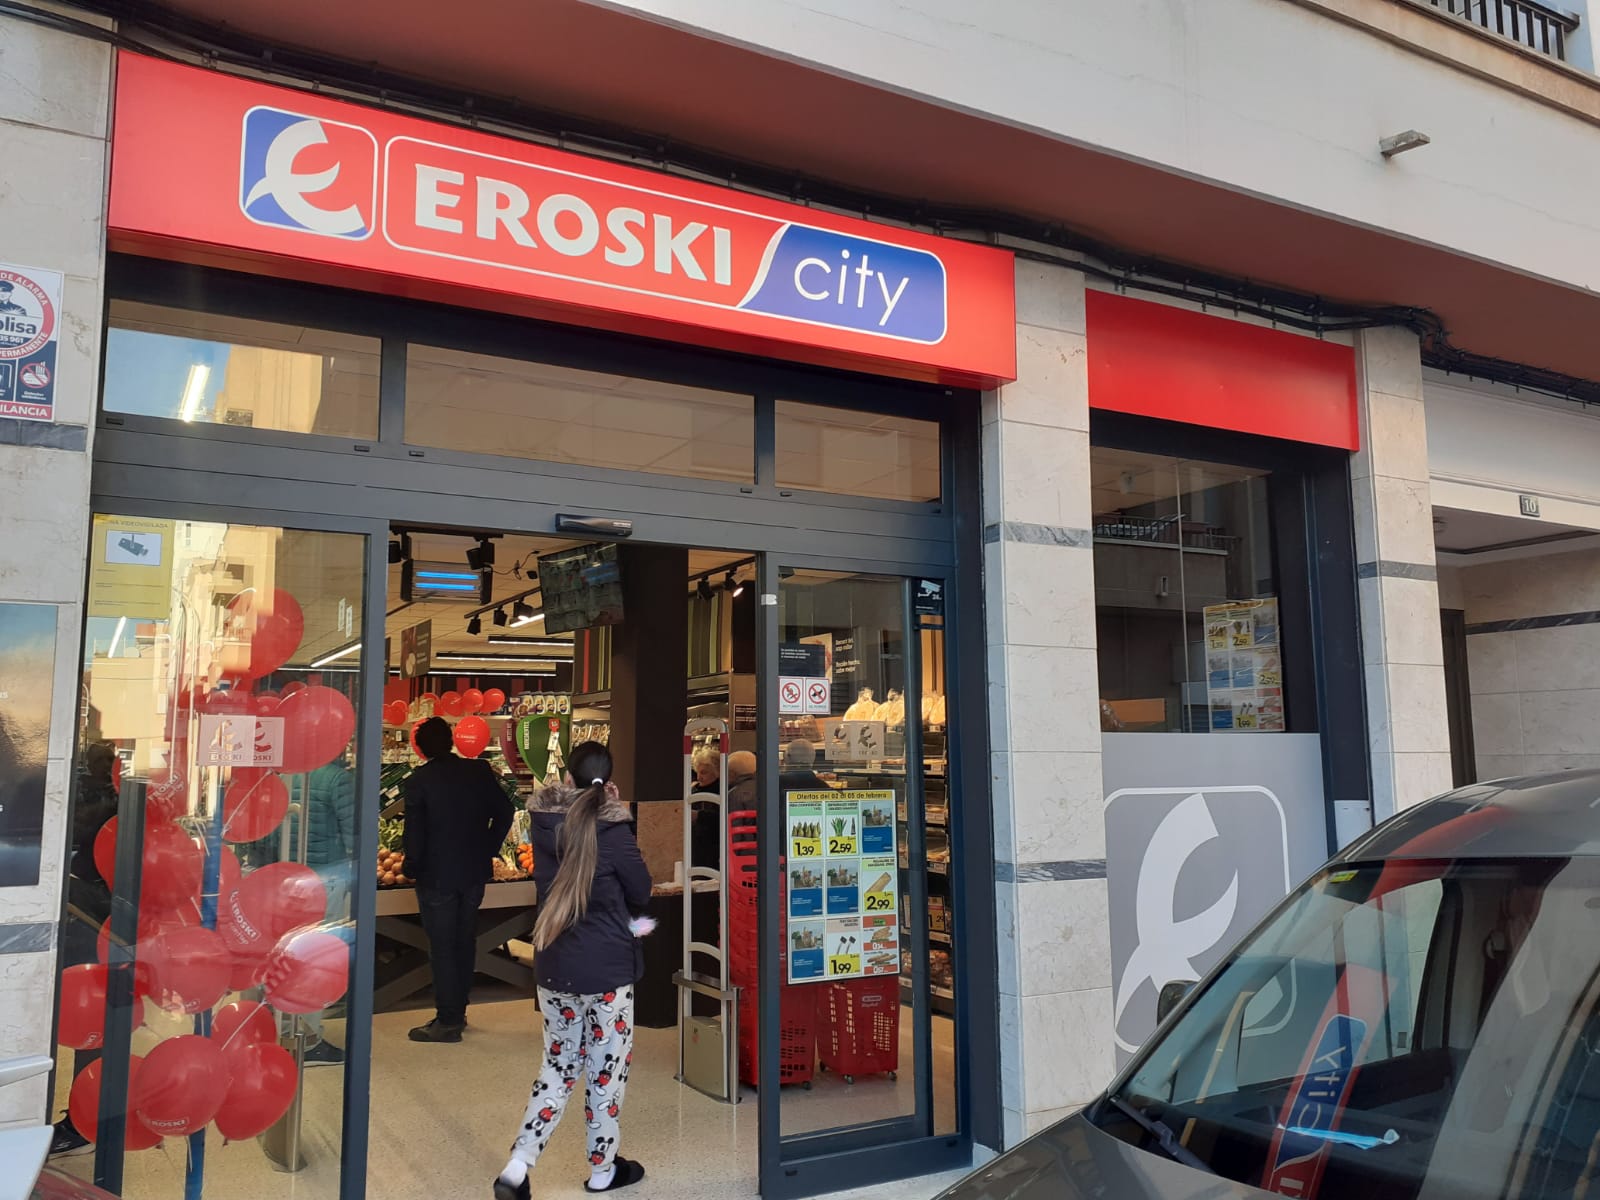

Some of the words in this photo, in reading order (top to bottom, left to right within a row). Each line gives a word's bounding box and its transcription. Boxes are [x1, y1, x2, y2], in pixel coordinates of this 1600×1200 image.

[414, 162, 732, 286] EROSKI
[0, 272, 14, 281] DE
[15, 276, 49, 306] ALARMA
[793, 249, 909, 327] city
[0, 331, 49, 358] ERMANENTE
[1524, 499, 1537, 513] 10
